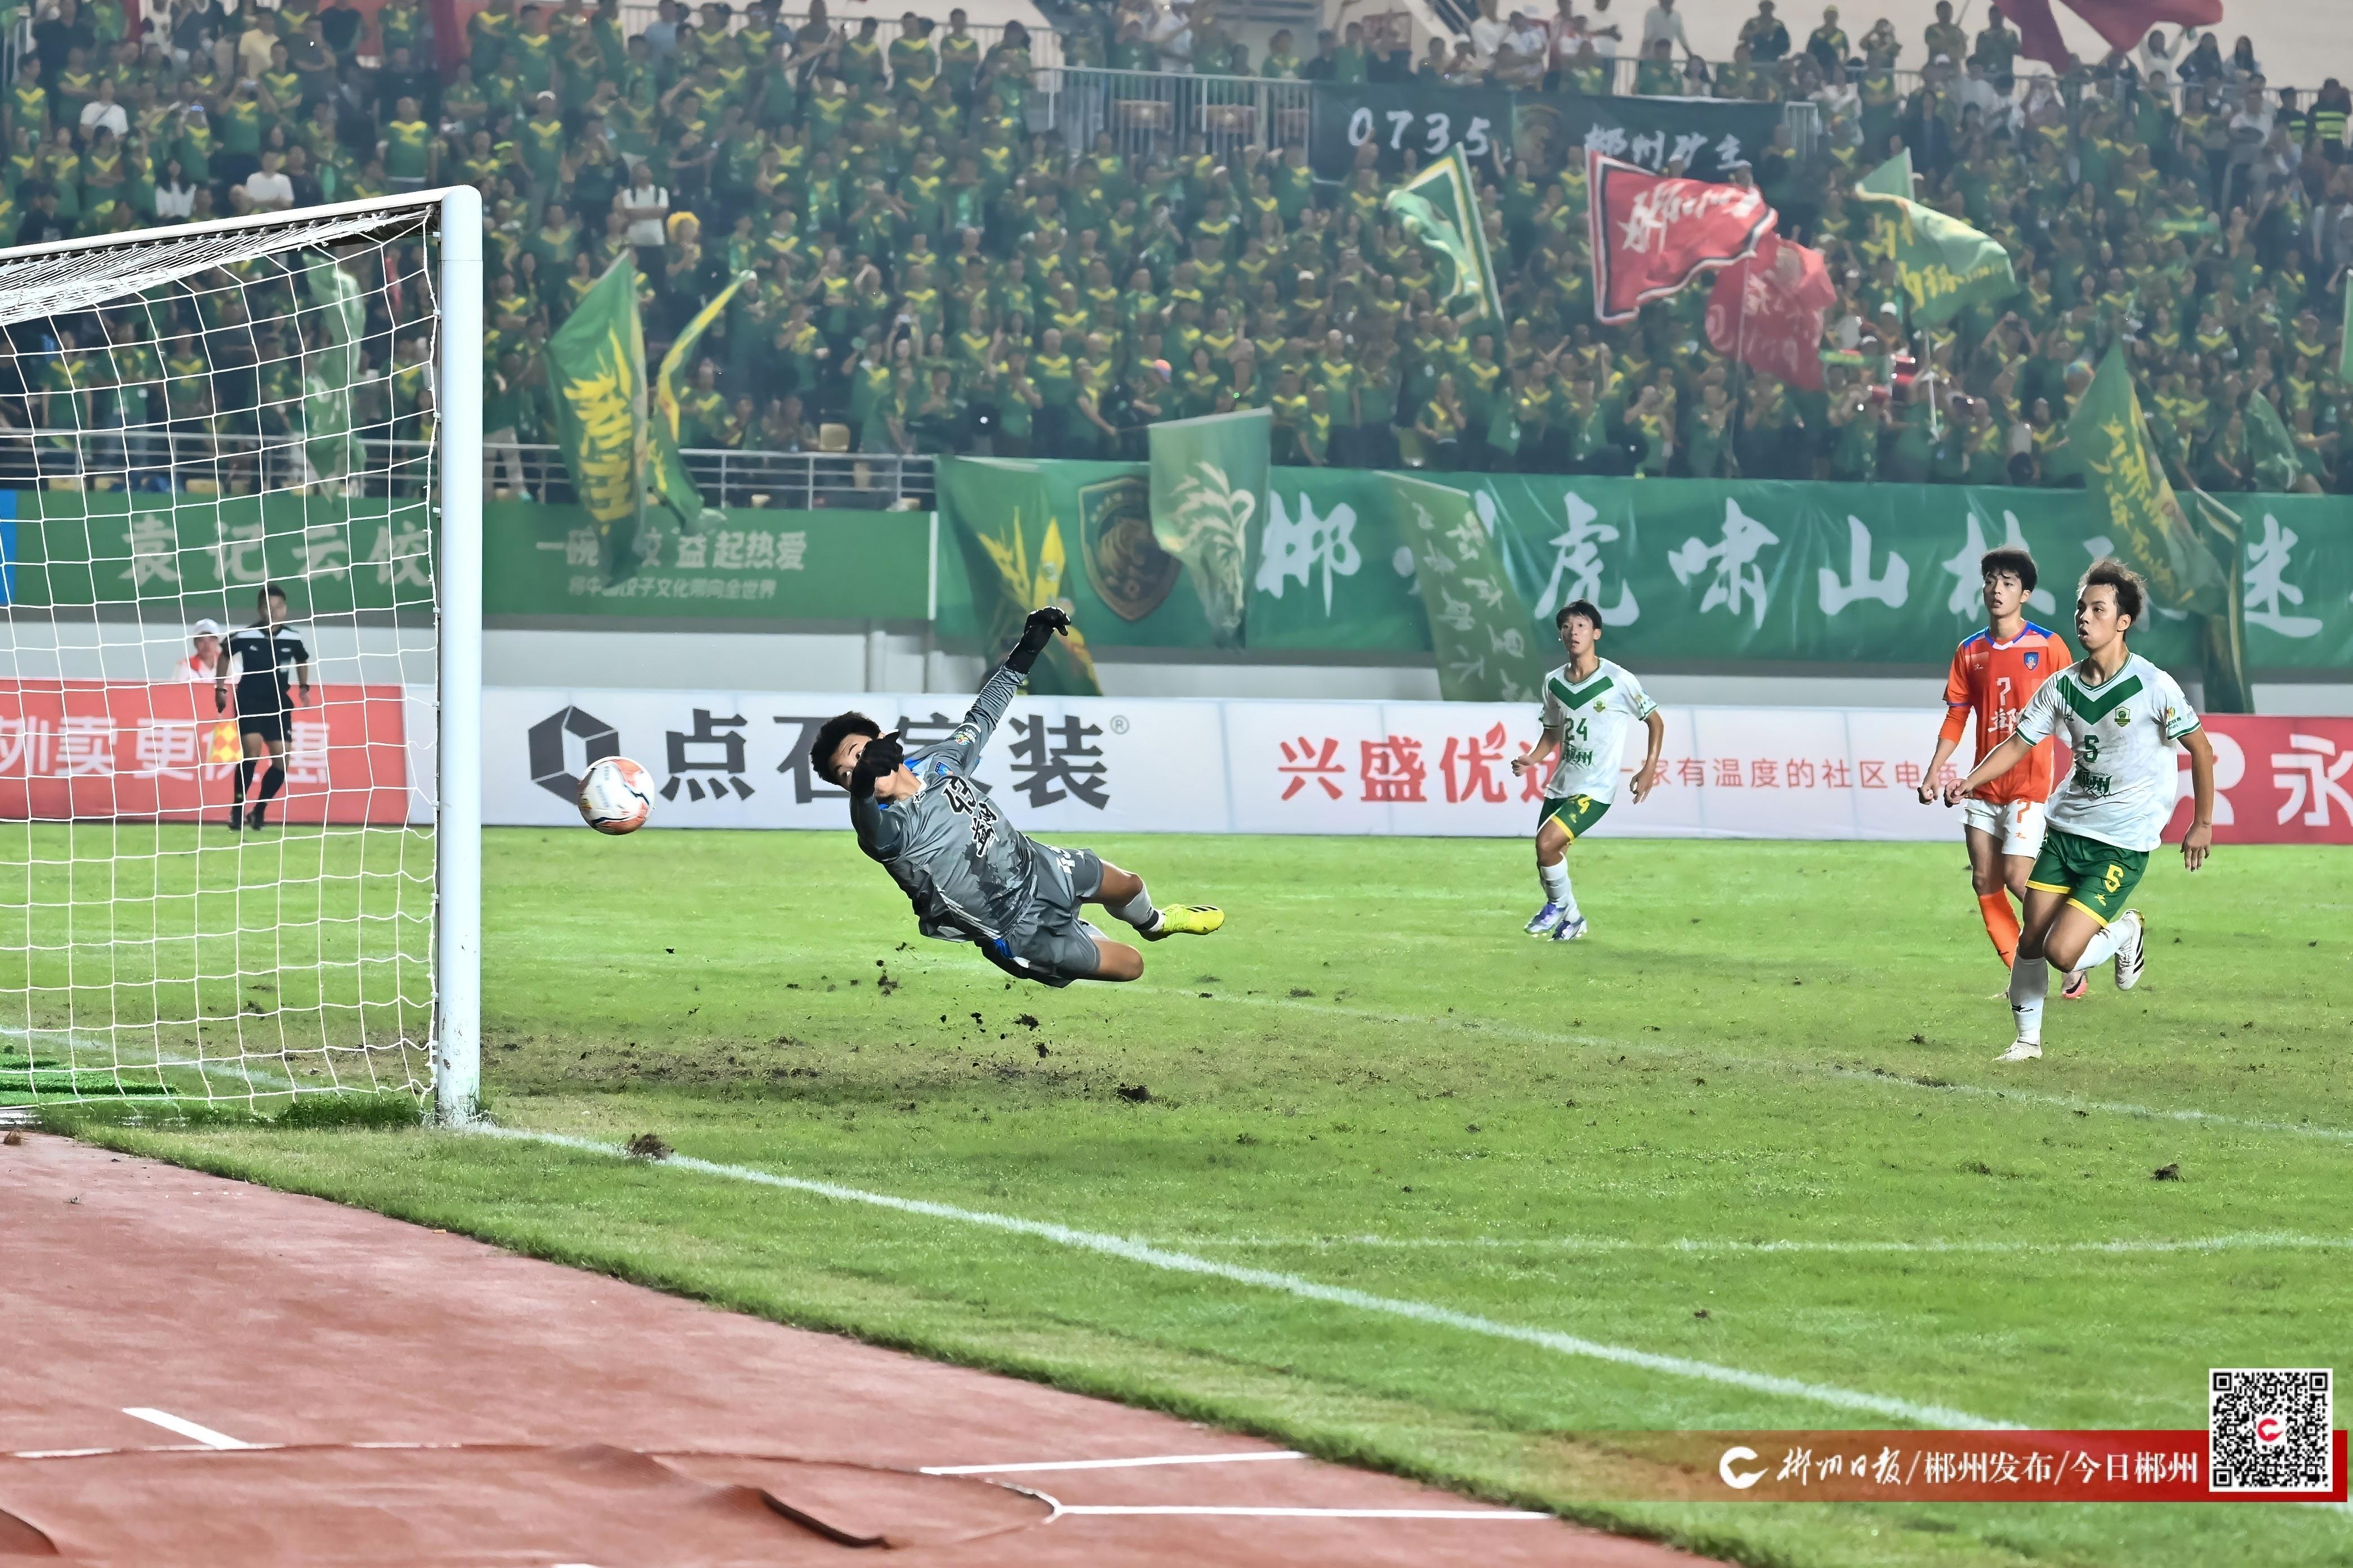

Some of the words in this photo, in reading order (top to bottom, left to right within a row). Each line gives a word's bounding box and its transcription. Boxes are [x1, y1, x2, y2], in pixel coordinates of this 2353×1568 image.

[1348, 107, 1491, 156] 0735
[118, 513, 433, 587] 袁记云饺
[1997, 677, 2011, 706] 7
[1564, 717, 1588, 742] 24
[0, 714, 330, 785] 外卖更惠
[2083, 734, 2099, 763] 5
[941, 775, 978, 816] 43
[2104, 864, 2124, 892] 5
